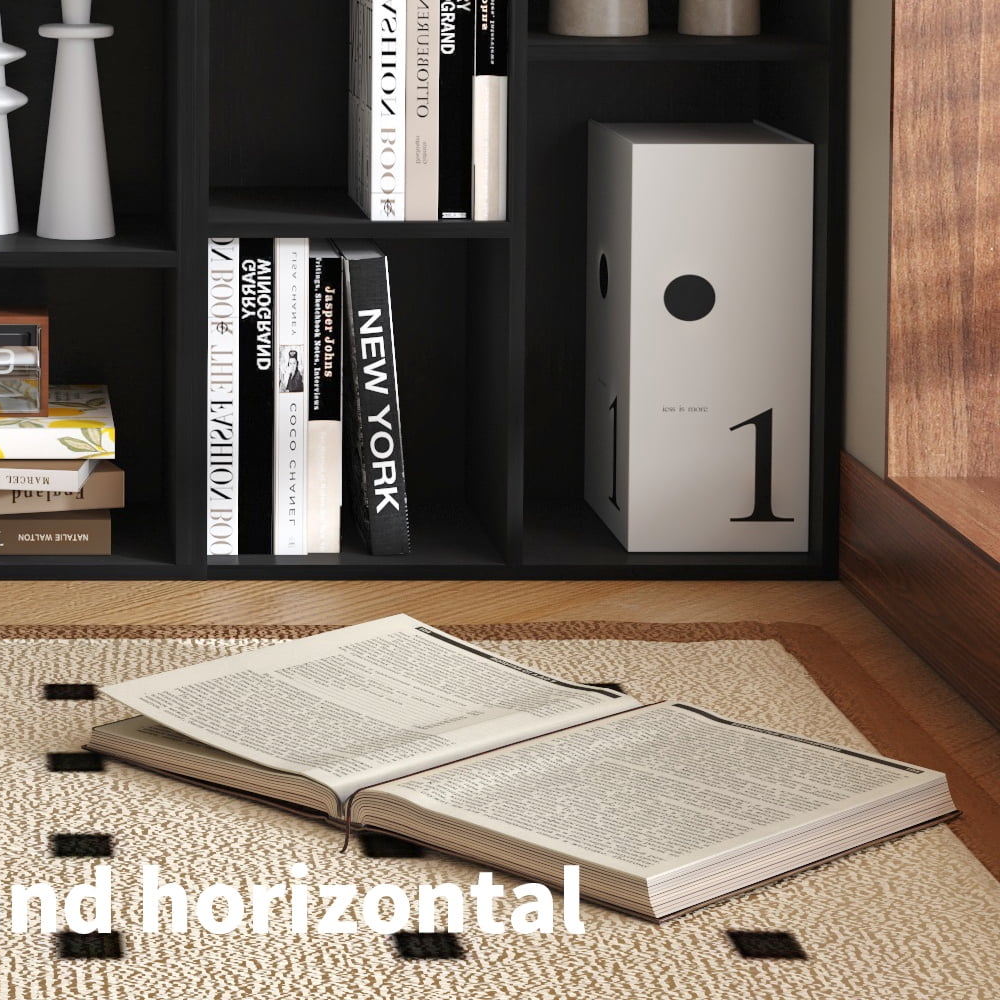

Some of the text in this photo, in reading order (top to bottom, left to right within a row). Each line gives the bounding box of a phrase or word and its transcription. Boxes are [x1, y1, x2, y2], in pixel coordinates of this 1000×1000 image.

[323, 286, 336, 378] Jasper Johns
[358, 309, 400, 514] NEW YORK
[609, 395, 620, 511] 1
[729, 408, 794, 522] 1
[6, 475, 50, 485] MARCEL
